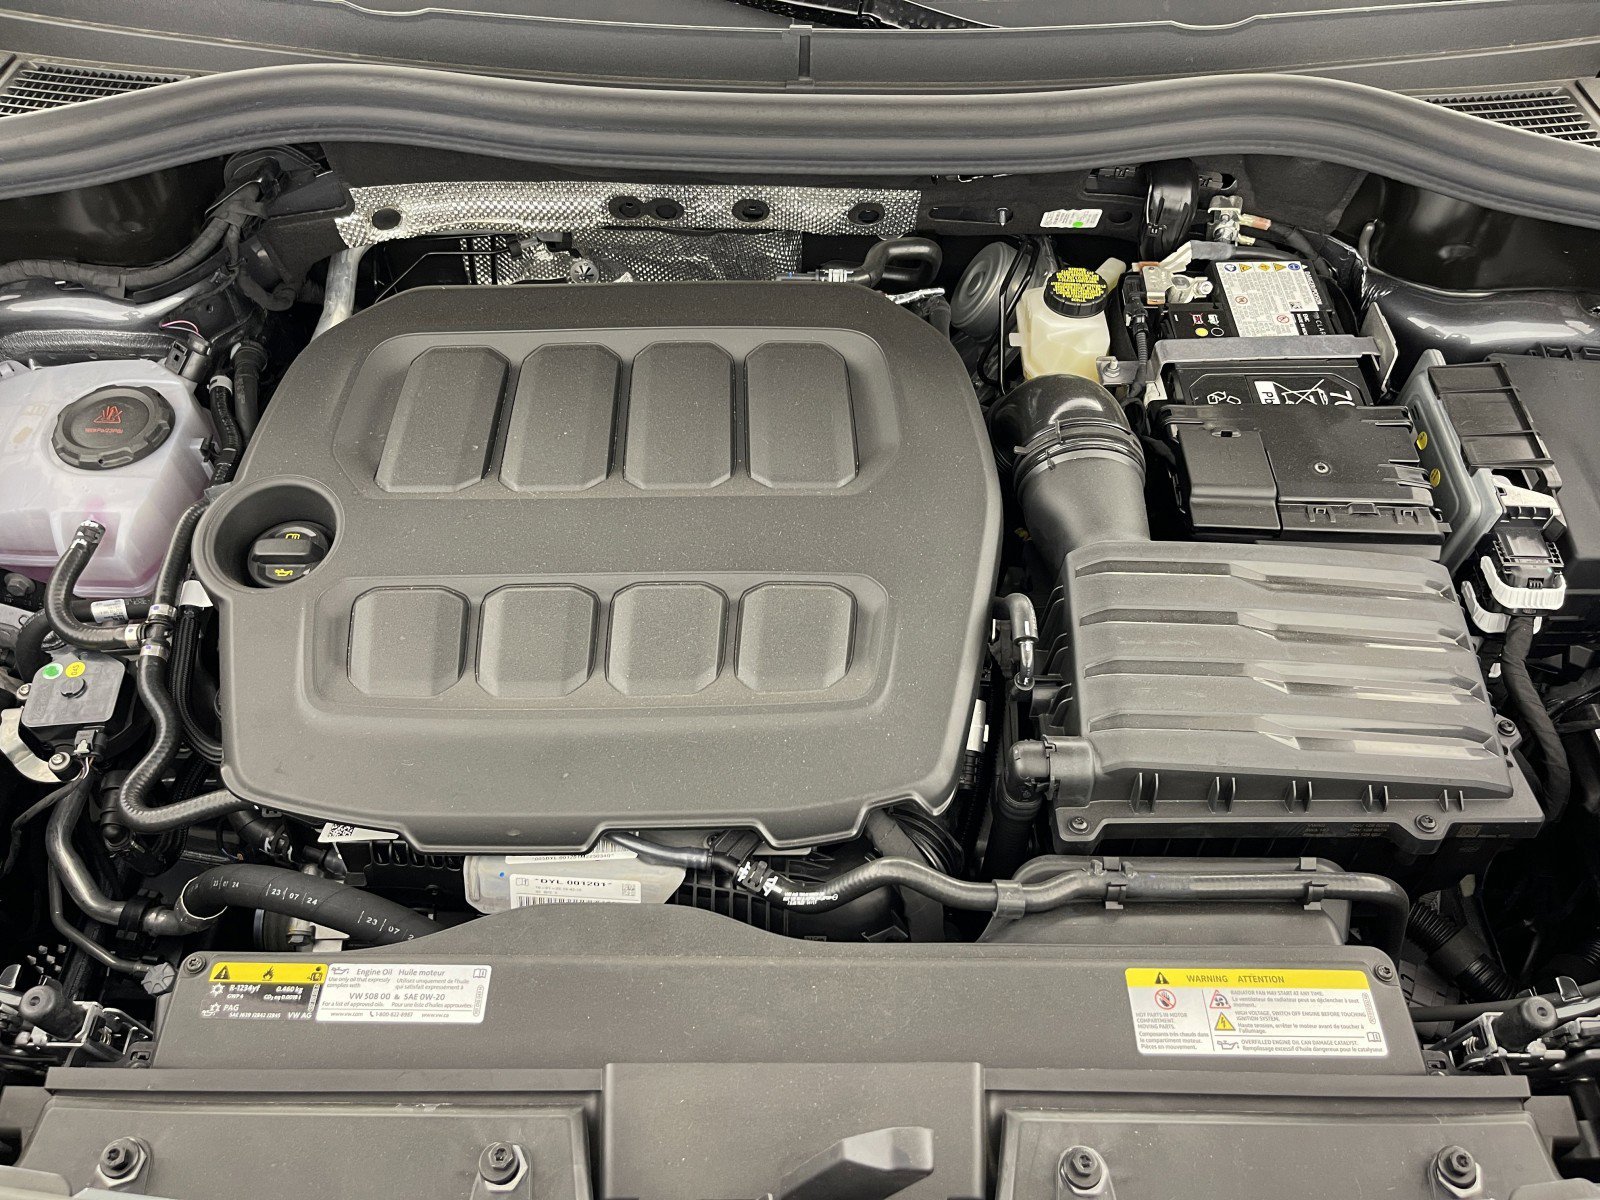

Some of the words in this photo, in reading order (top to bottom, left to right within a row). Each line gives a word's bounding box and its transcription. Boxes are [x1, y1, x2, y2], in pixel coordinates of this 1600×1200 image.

[289, 892, 299, 900] 07
[307, 897, 317, 905] 24
[366, 916, 377, 926] 23
[388, 925, 400, 934] 07
[357, 968, 381, 977] Engine
[382, 968, 393, 976] Oil
[419, 969, 446, 977] moteur
[1186, 975, 1228, 983] WARNING
[1238, 975, 1285, 983] ATTENTION
[229, 984, 261, 993] R-1234yf
[349, 992, 363, 1000] VW
[419, 993, 446, 1001] 0W-20
[287, 1011, 301, 1019] VW
